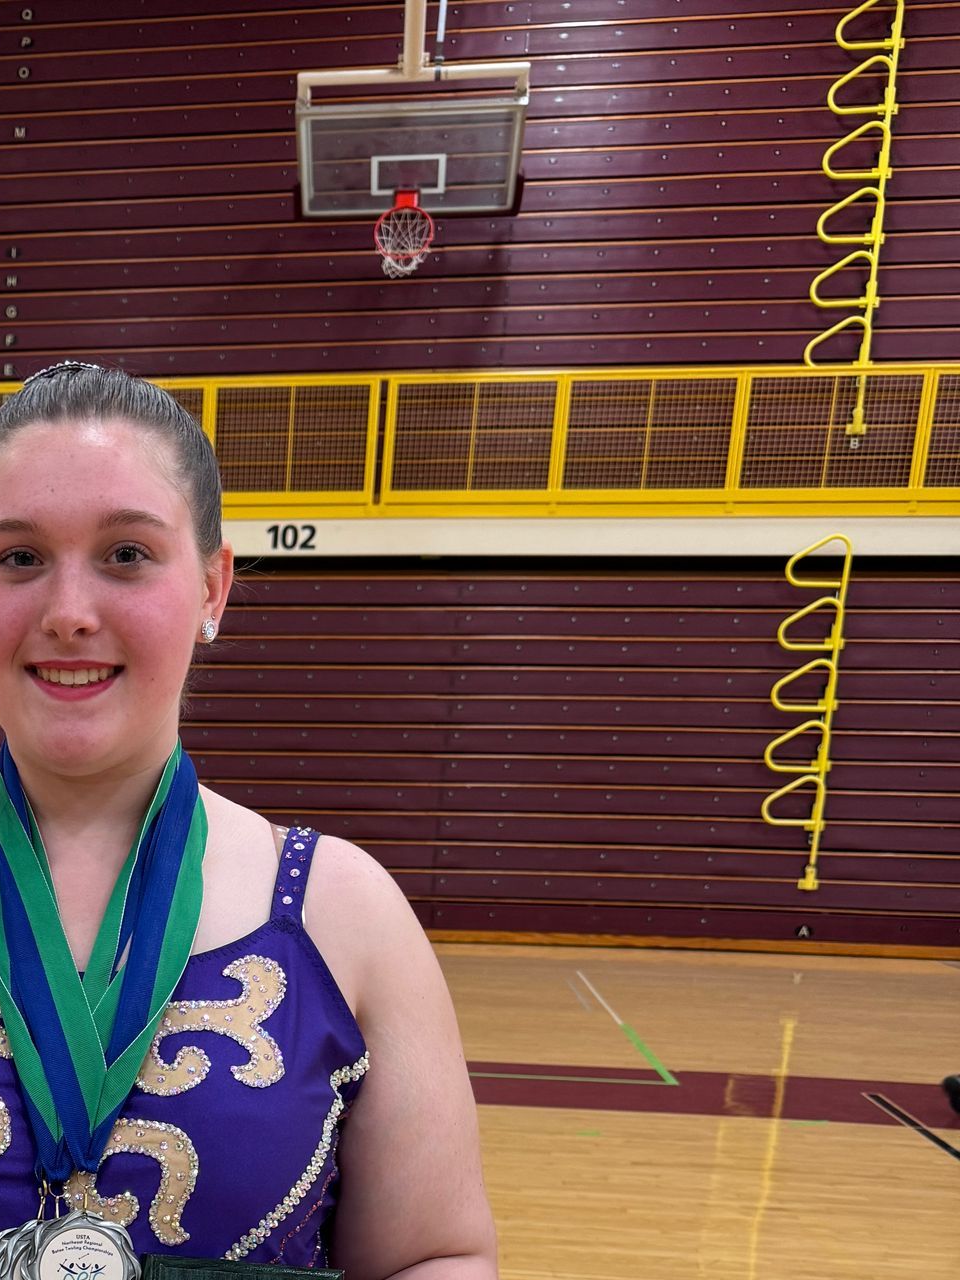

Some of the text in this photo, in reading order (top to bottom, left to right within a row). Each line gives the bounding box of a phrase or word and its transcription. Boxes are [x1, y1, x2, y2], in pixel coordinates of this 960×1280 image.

[21, 36, 32, 48] P
[6, 275, 18, 287] H
[266, 524, 316, 550] 102
[798, 925, 810, 937] A
